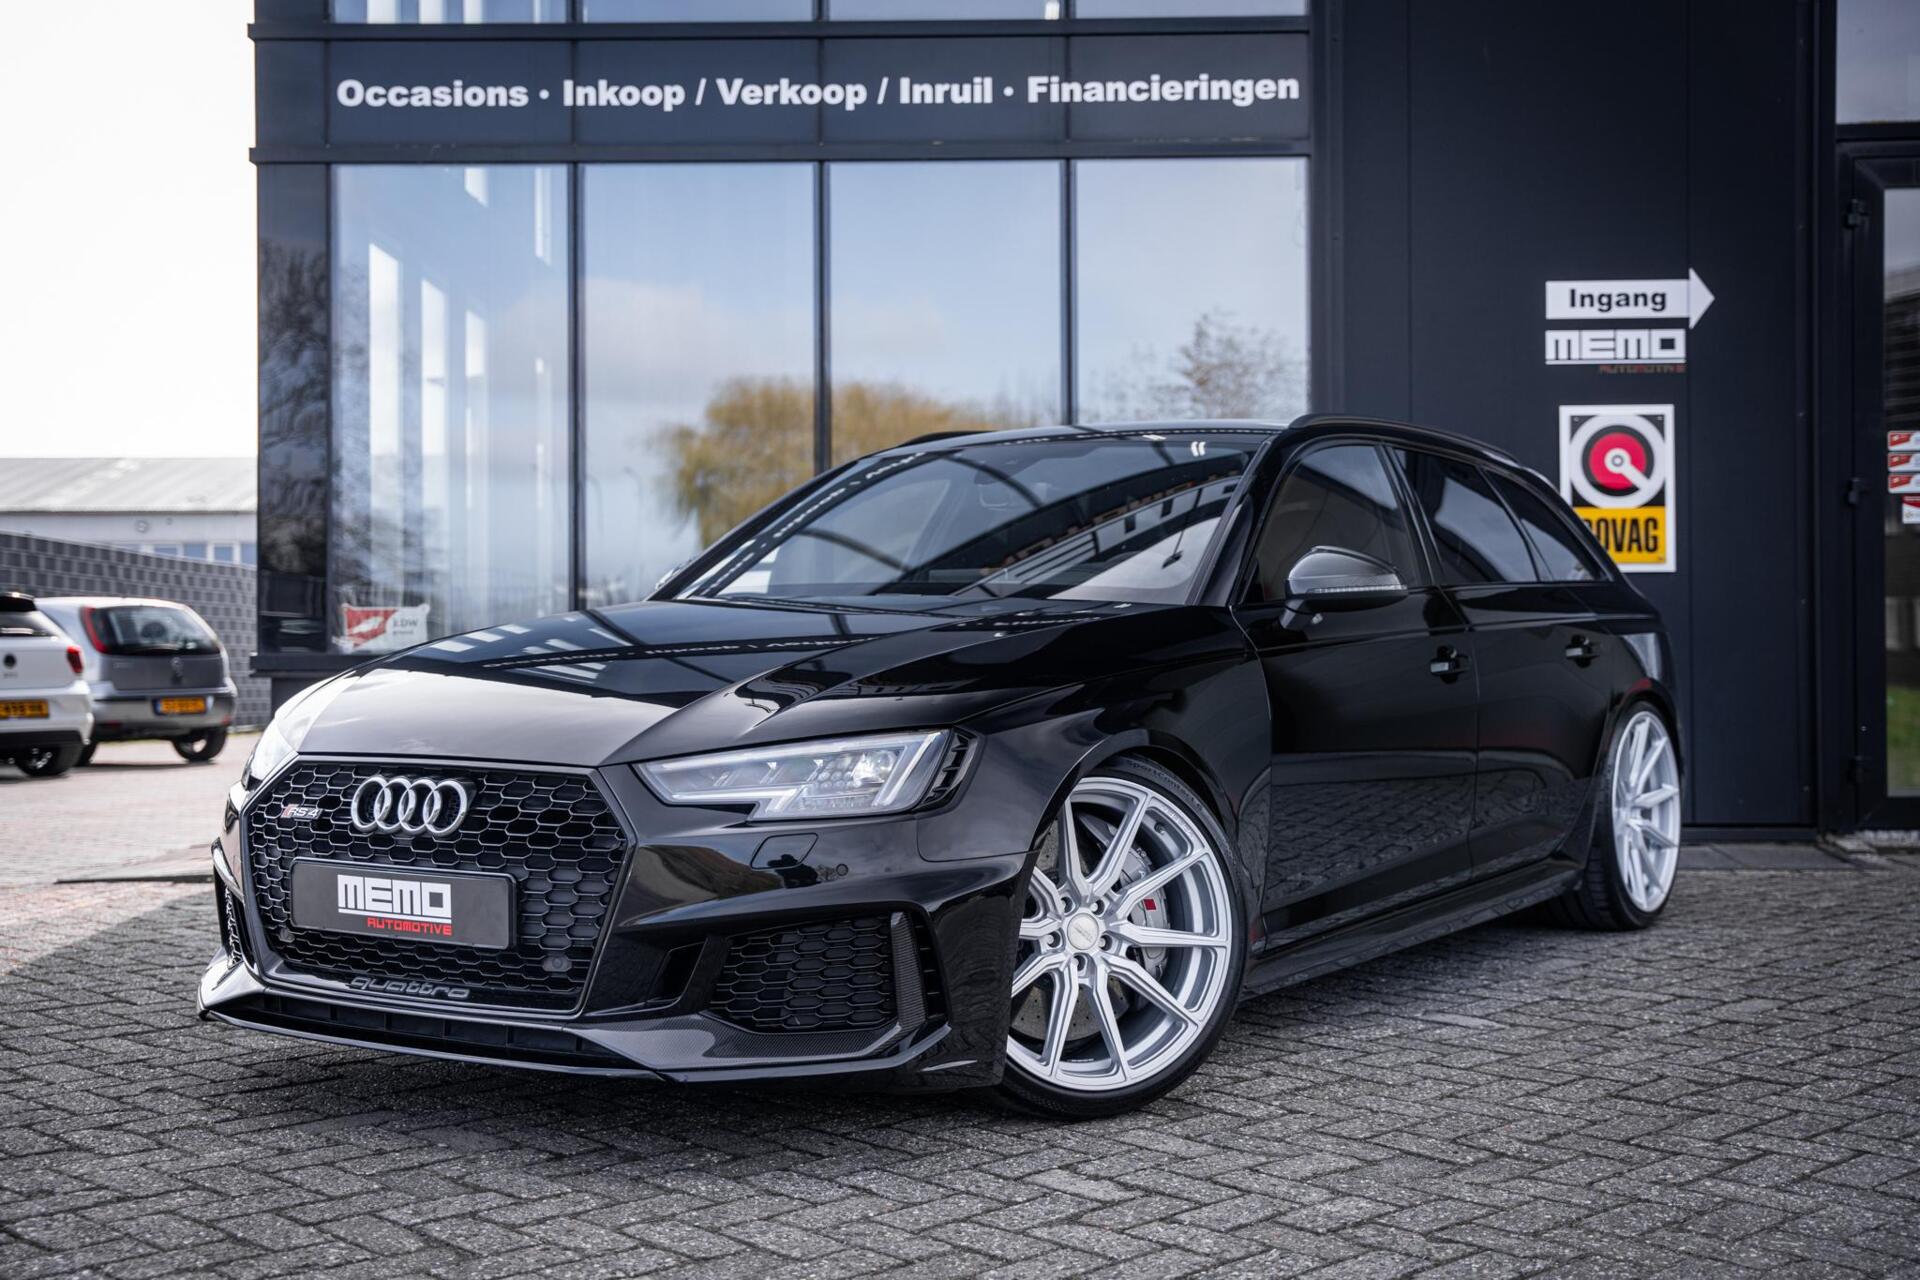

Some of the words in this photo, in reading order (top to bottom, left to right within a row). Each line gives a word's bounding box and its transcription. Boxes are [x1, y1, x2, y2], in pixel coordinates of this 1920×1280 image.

[336, 78, 530, 108] Occasions
[562, 78, 687, 112] Inkoop
[715, 77, 868, 112] Verkoop
[899, 76, 993, 105] Inruil
[1027, 73, 1301, 107] Financieringen
[1569, 288, 1667, 312] Ingang
[1545, 328, 1686, 360] MEMO
[285, 806, 319, 818] RS4
[337, 874, 452, 919] MEMO
[366, 916, 452, 936] AUTOMOTIVE
[350, 976, 470, 998] quattro
